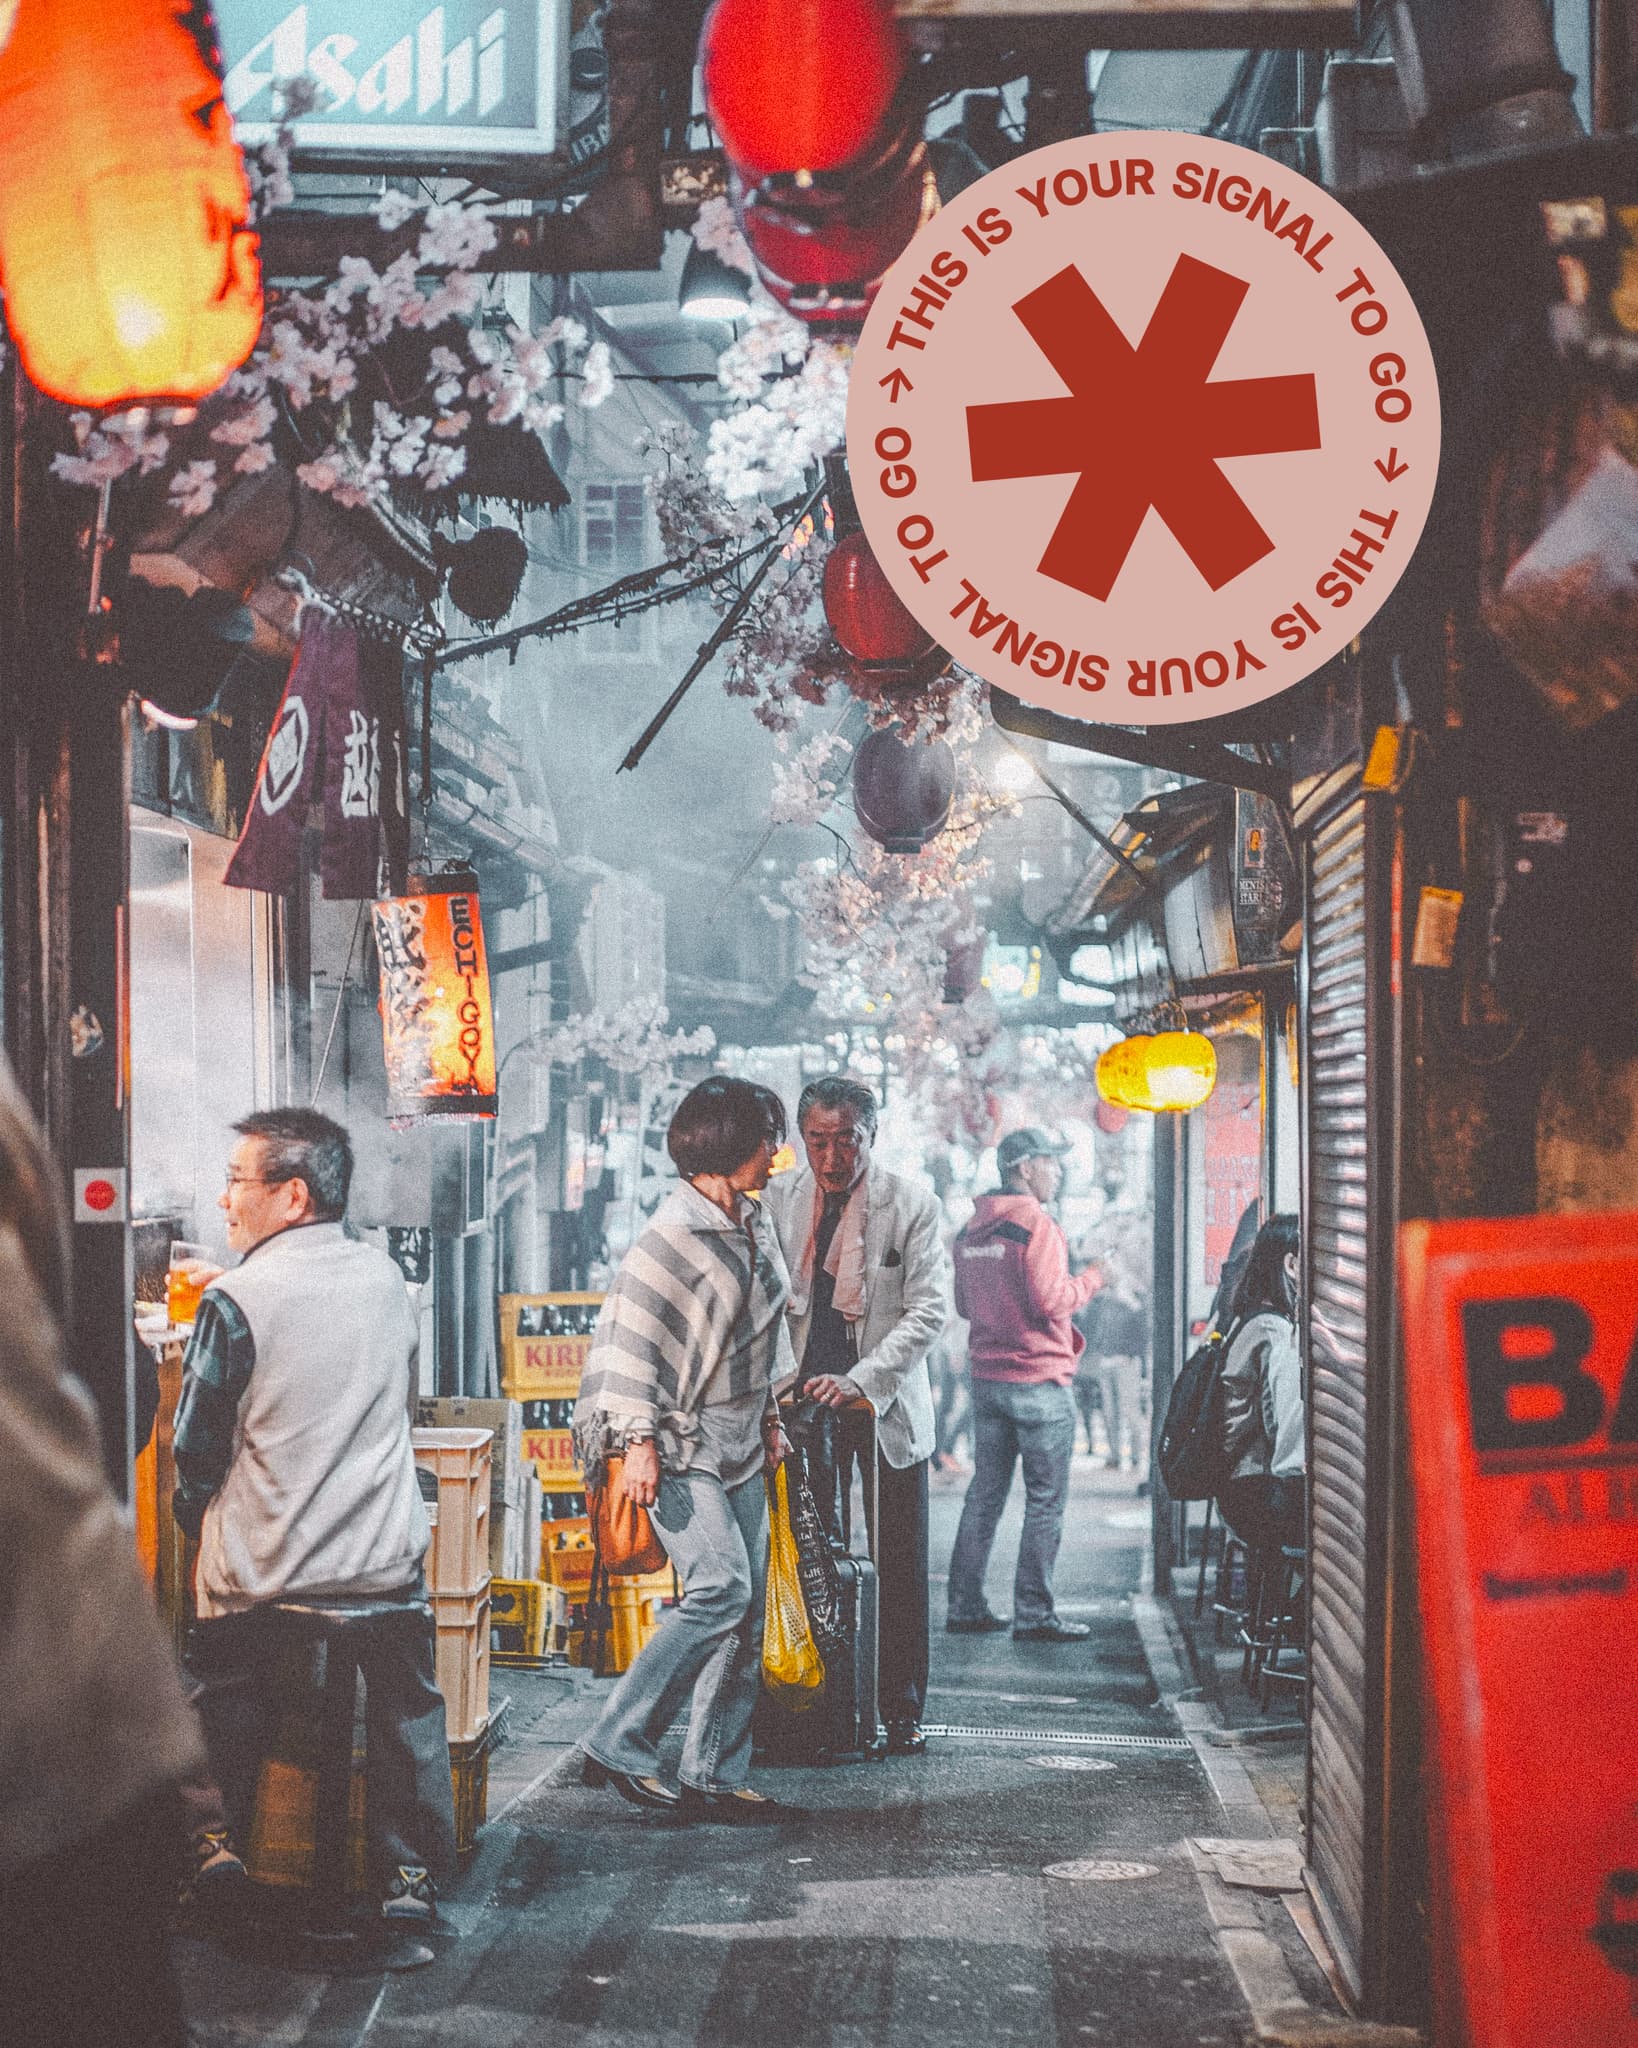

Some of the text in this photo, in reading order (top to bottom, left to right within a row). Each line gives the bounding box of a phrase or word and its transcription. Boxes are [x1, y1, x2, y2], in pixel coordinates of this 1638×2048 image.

[223, 5, 505, 118] Asahi
[450, 897, 483, 1096] ECHIGOYA
[525, 1343, 590, 1369] KIRI
[1461, 1295, 1638, 1453] B
